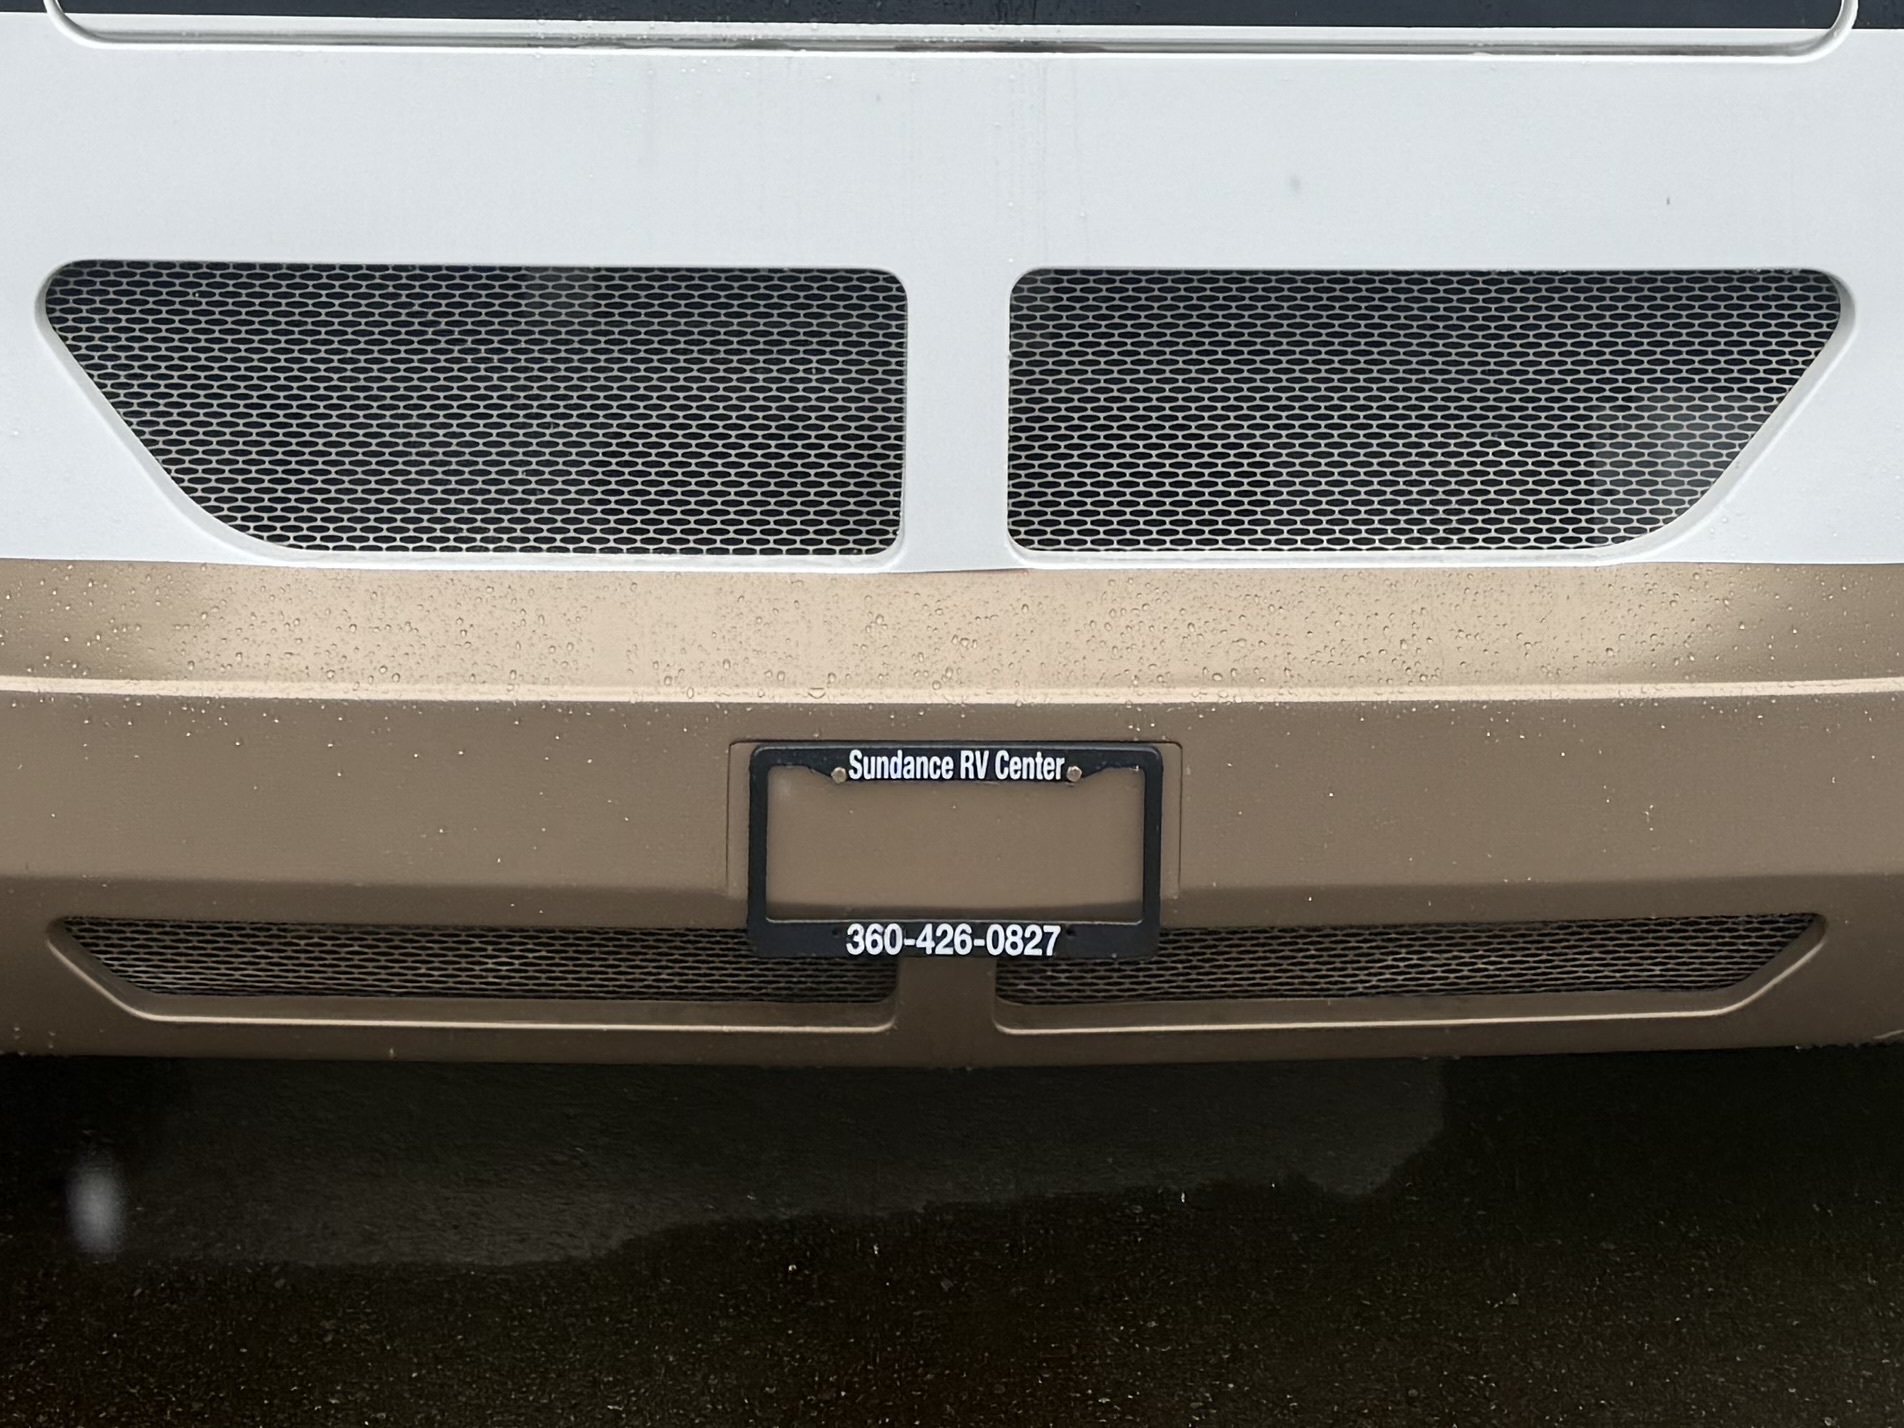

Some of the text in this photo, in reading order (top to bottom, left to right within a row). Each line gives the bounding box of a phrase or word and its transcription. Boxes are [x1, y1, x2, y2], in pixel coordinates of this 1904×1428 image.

[848, 749, 1066, 781] Sundance RV Center
[846, 922, 1062, 956] 360-426-0827
